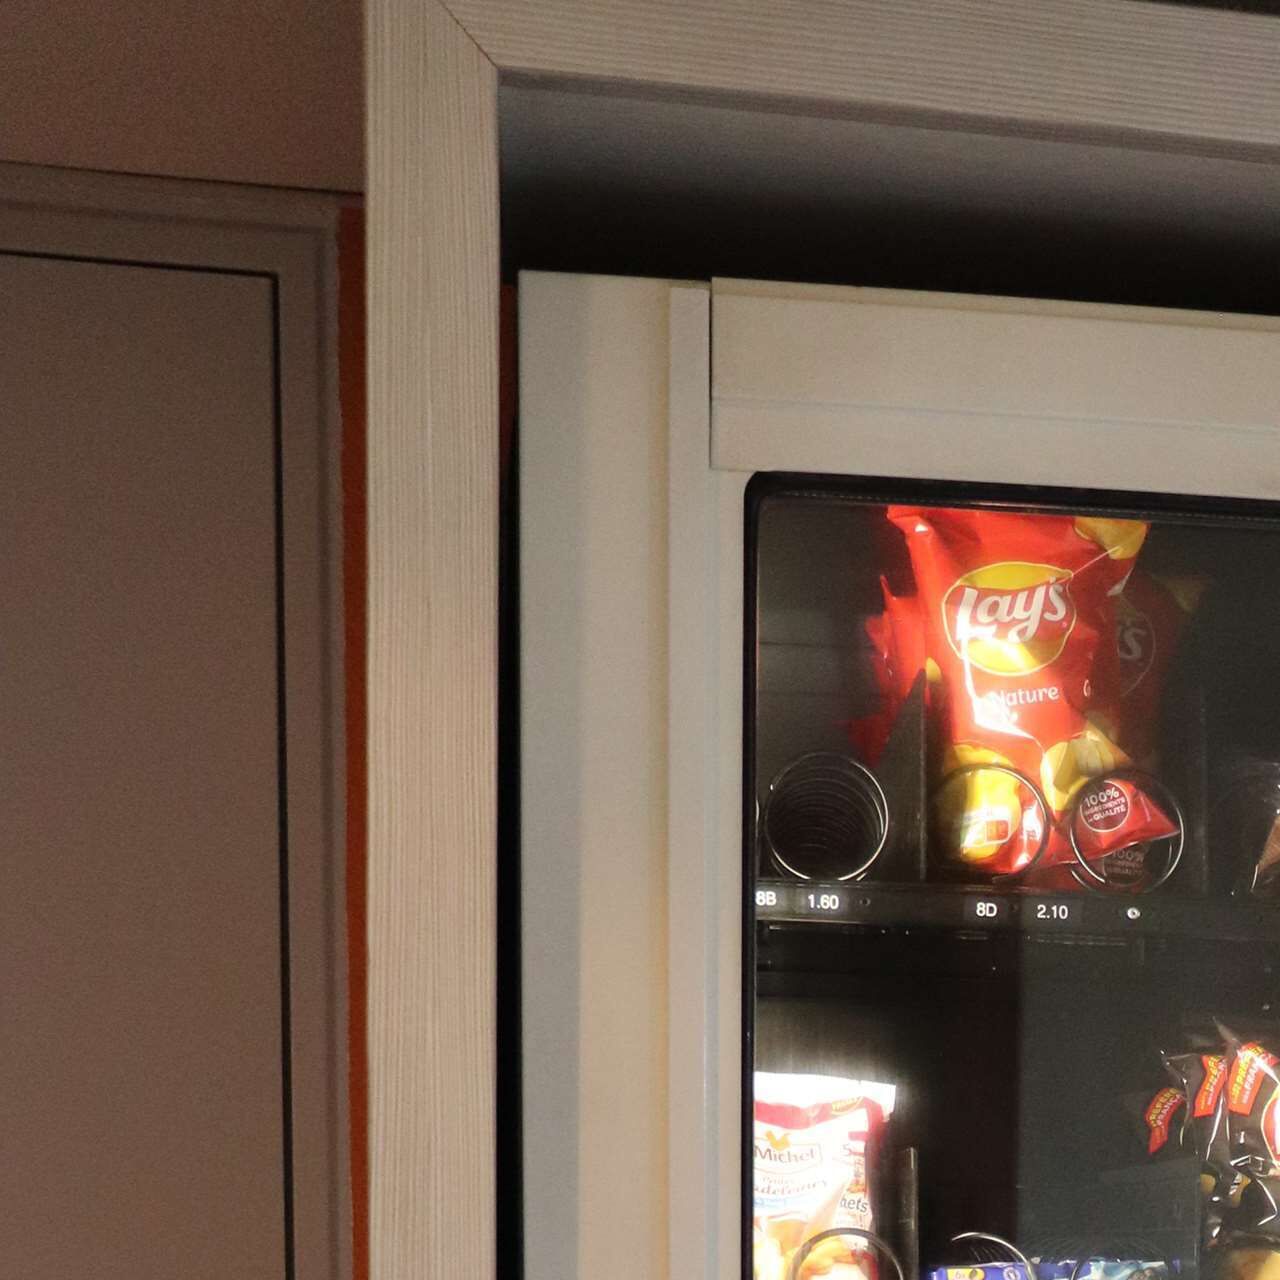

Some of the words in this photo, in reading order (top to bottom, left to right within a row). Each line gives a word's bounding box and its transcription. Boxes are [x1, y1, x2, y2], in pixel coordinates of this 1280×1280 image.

[956, 577, 1066, 642] Lay's
[1084, 786, 1120, 807] 100%
[755, 890, 777, 906] 8B
[808, 894, 840, 910] 1.60
[976, 901, 998, 917] 8D
[1037, 904, 1069, 920] 2.10
